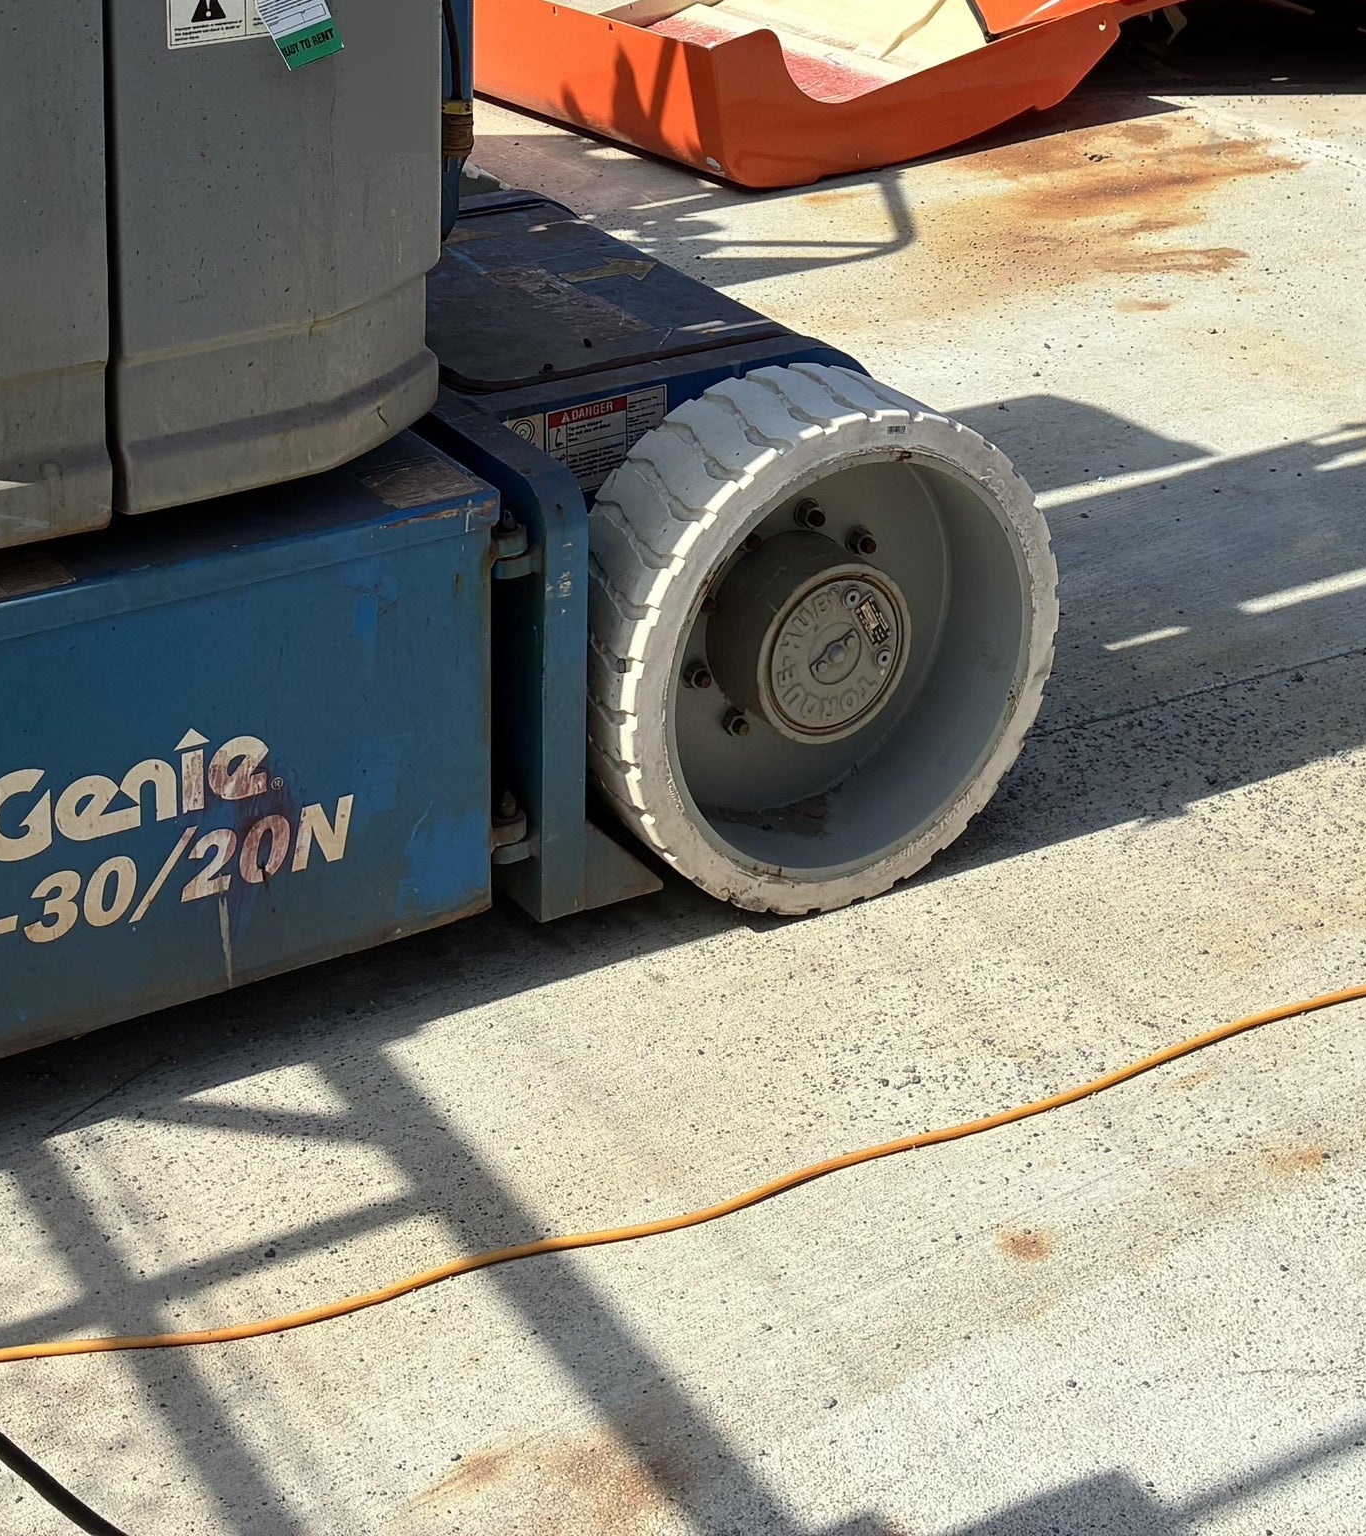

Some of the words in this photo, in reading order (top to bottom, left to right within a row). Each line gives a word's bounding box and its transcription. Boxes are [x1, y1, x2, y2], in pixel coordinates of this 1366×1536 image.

[300, 37, 312, 49] TO
[312, 27, 334, 46] RENT
[571, 402, 613, 421] DANGER
